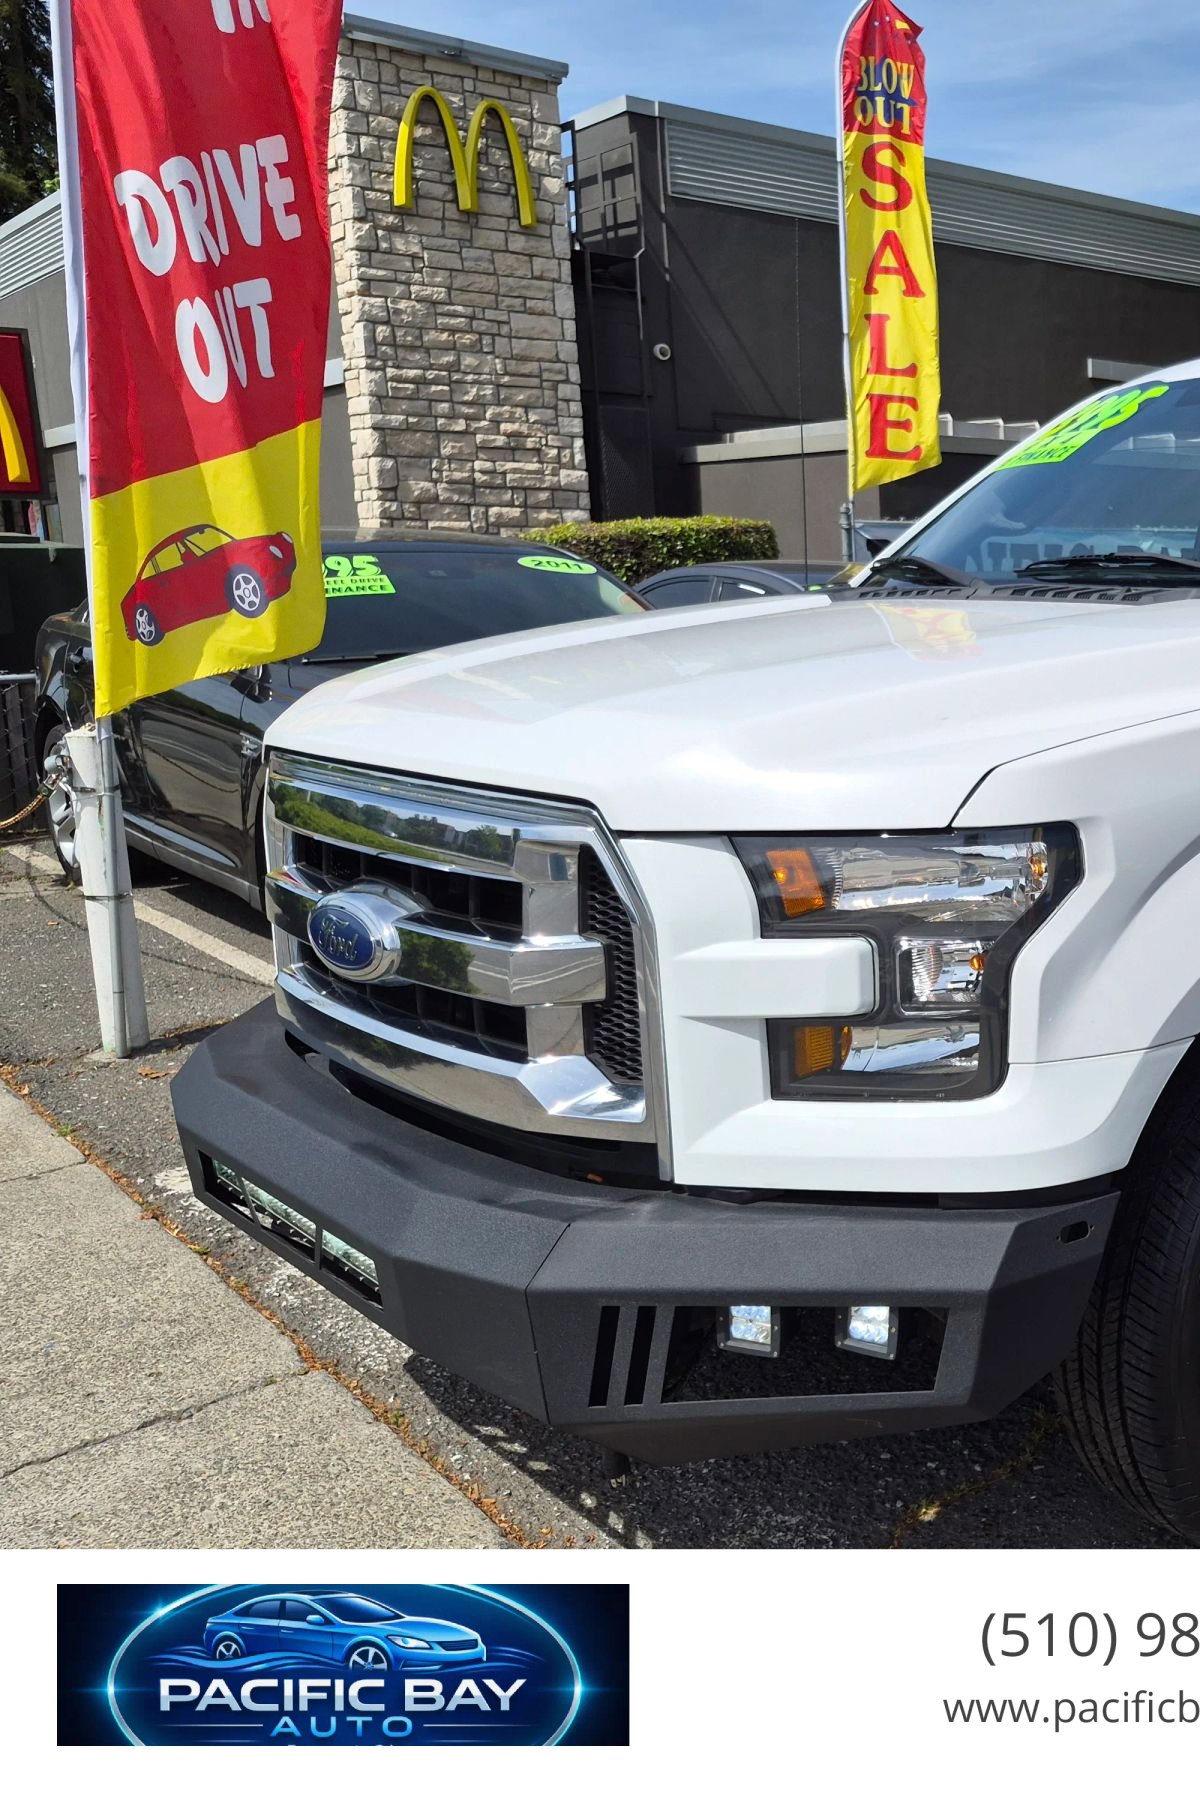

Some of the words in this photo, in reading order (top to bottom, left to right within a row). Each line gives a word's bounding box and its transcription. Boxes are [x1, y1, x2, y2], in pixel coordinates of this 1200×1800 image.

[856, 56, 915, 99] BLOW
[854, 96, 911, 135] OUT
[114, 134, 302, 276] DRIVE
[860, 142, 926, 462] SALE
[175, 277, 275, 403] OUT
[322, 555, 382, 577] 95
[531, 559, 584, 571] 2011
[325, 584, 388, 595] INANCE
